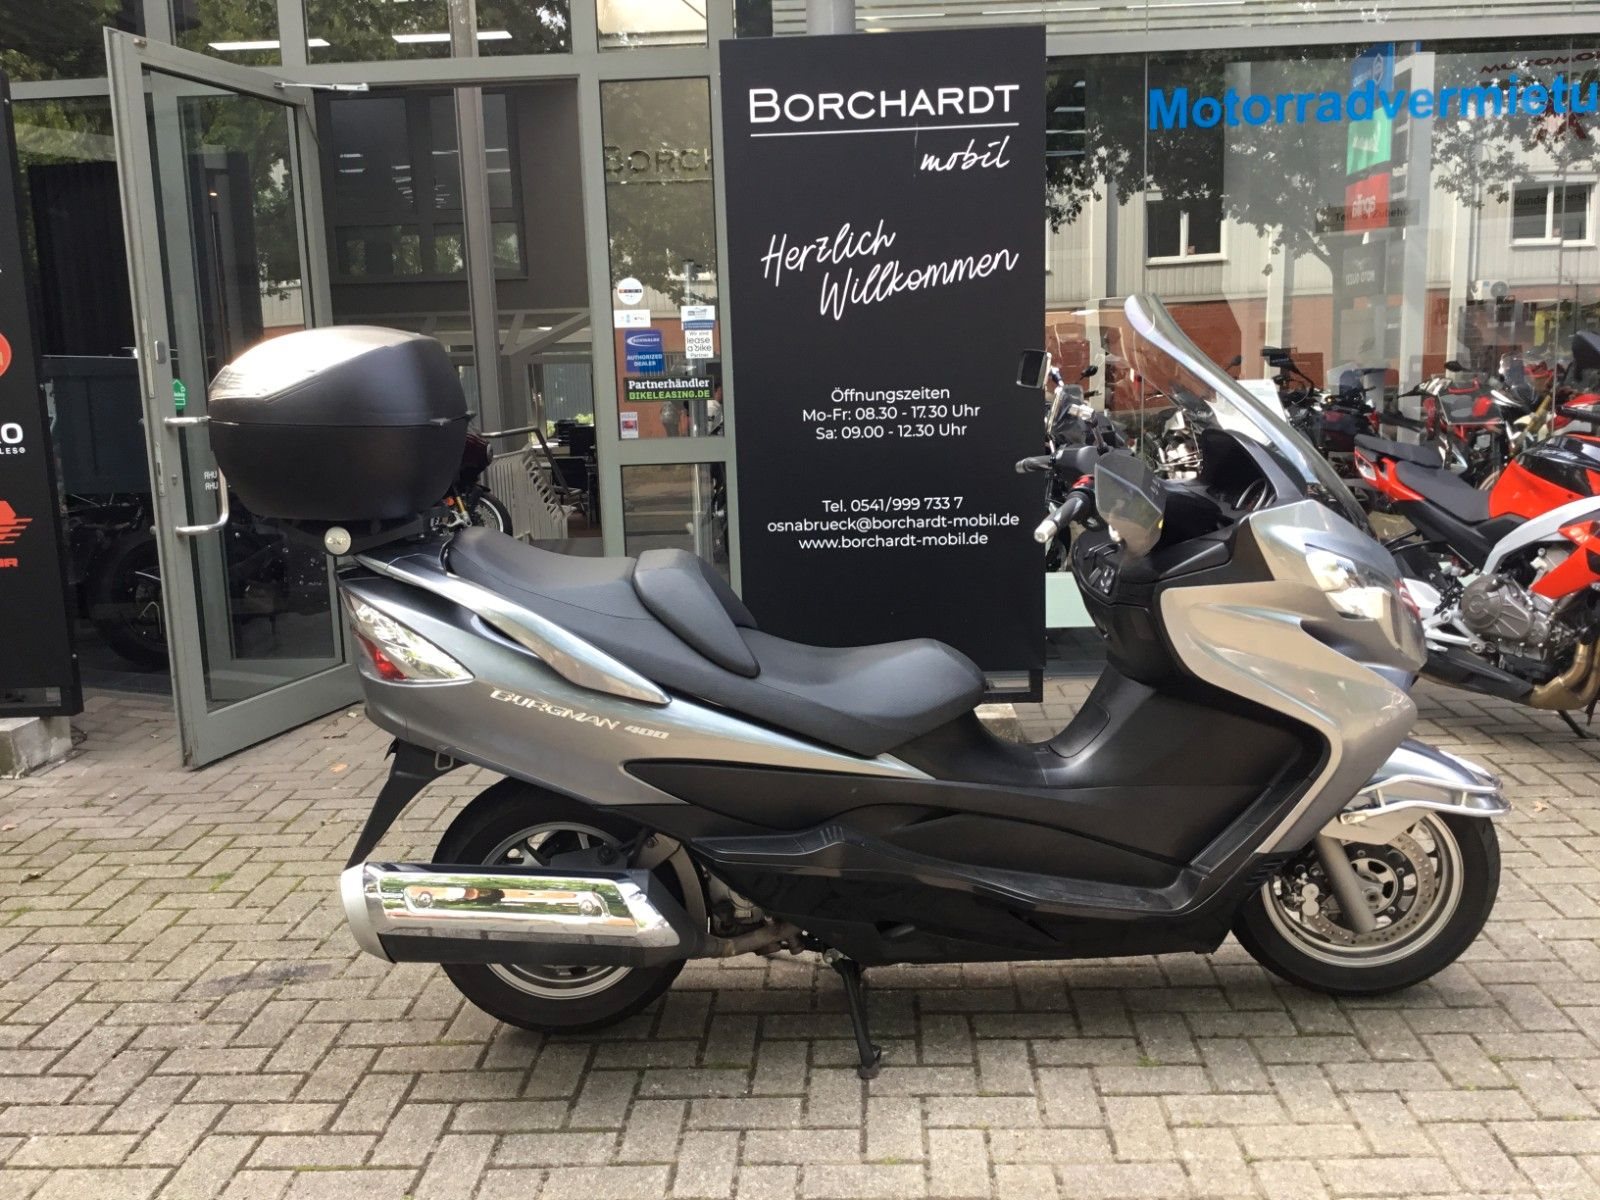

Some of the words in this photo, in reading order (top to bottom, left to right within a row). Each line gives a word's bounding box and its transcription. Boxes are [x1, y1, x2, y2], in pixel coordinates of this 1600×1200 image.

[749, 84, 1020, 123] BORCHARDT
[919, 135, 1010, 171] mobil
[760, 218, 896, 287] Herzlich
[819, 248, 1019, 321] Willkommen
[687, 336, 711, 344] lease
[628, 378, 710, 389] Partnerhändler
[629, 389, 711, 400] BIKELEASING.DE
[831, 387, 950, 403] Öffnungszeiten
[802, 409, 851, 422] Mo-Fr:
[855, 407, 898, 420] 08.30
[911, 405, 948, 419] 17.30
[952, 404, 981, 417] Uhr
[815, 427, 838, 440] Sa:
[841, 426, 884, 439] 09.00
[897, 424, 935, 437] 12.30
[939, 423, 968, 436] Uhr
[822, 500, 847, 512] Tel.
[850, 497, 921, 512] 0541/999
[924, 498, 950, 510] 733
[767, 513, 1020, 532] osnabrueck@borchardt-mobil.de
[799, 532, 989, 548] www.borchardt-mobil.de
[489, 687, 620, 731] BURGMAN
[623, 724, 670, 740] 400
